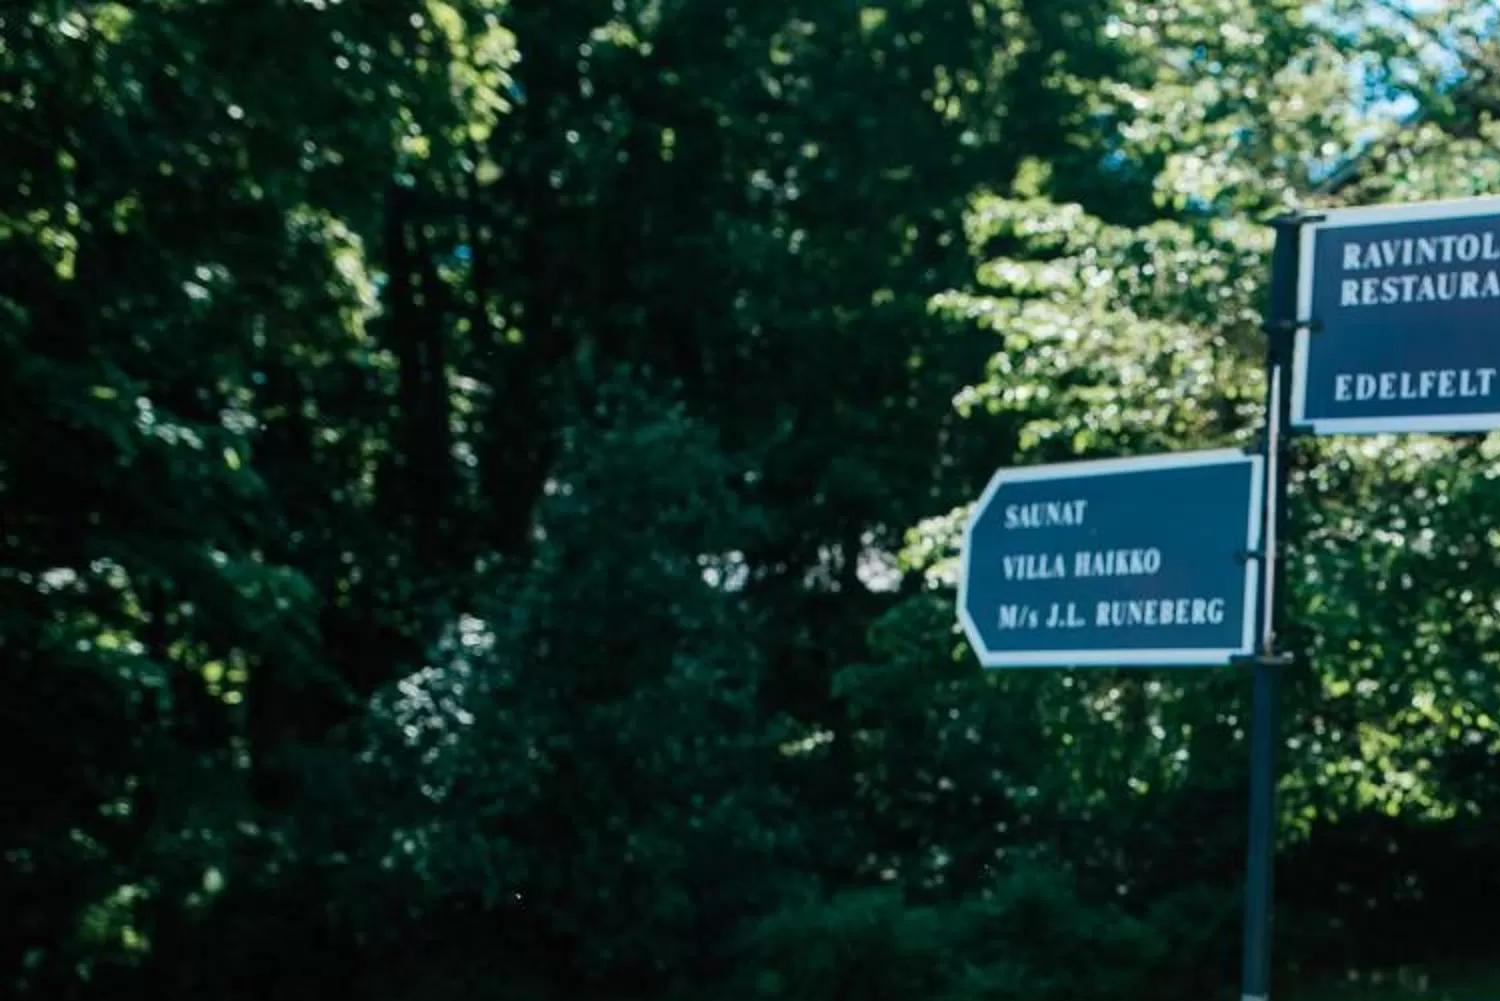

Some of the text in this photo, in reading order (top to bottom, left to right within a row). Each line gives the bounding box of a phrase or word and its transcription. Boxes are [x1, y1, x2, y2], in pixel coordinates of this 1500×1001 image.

[1335, 368, 1496, 402] EDELFELT
[1004, 500, 1088, 530] SAUNAT
[1003, 547, 1161, 581] VILLA HAIKKO
[1096, 598, 1225, 627] RUNEBERG
